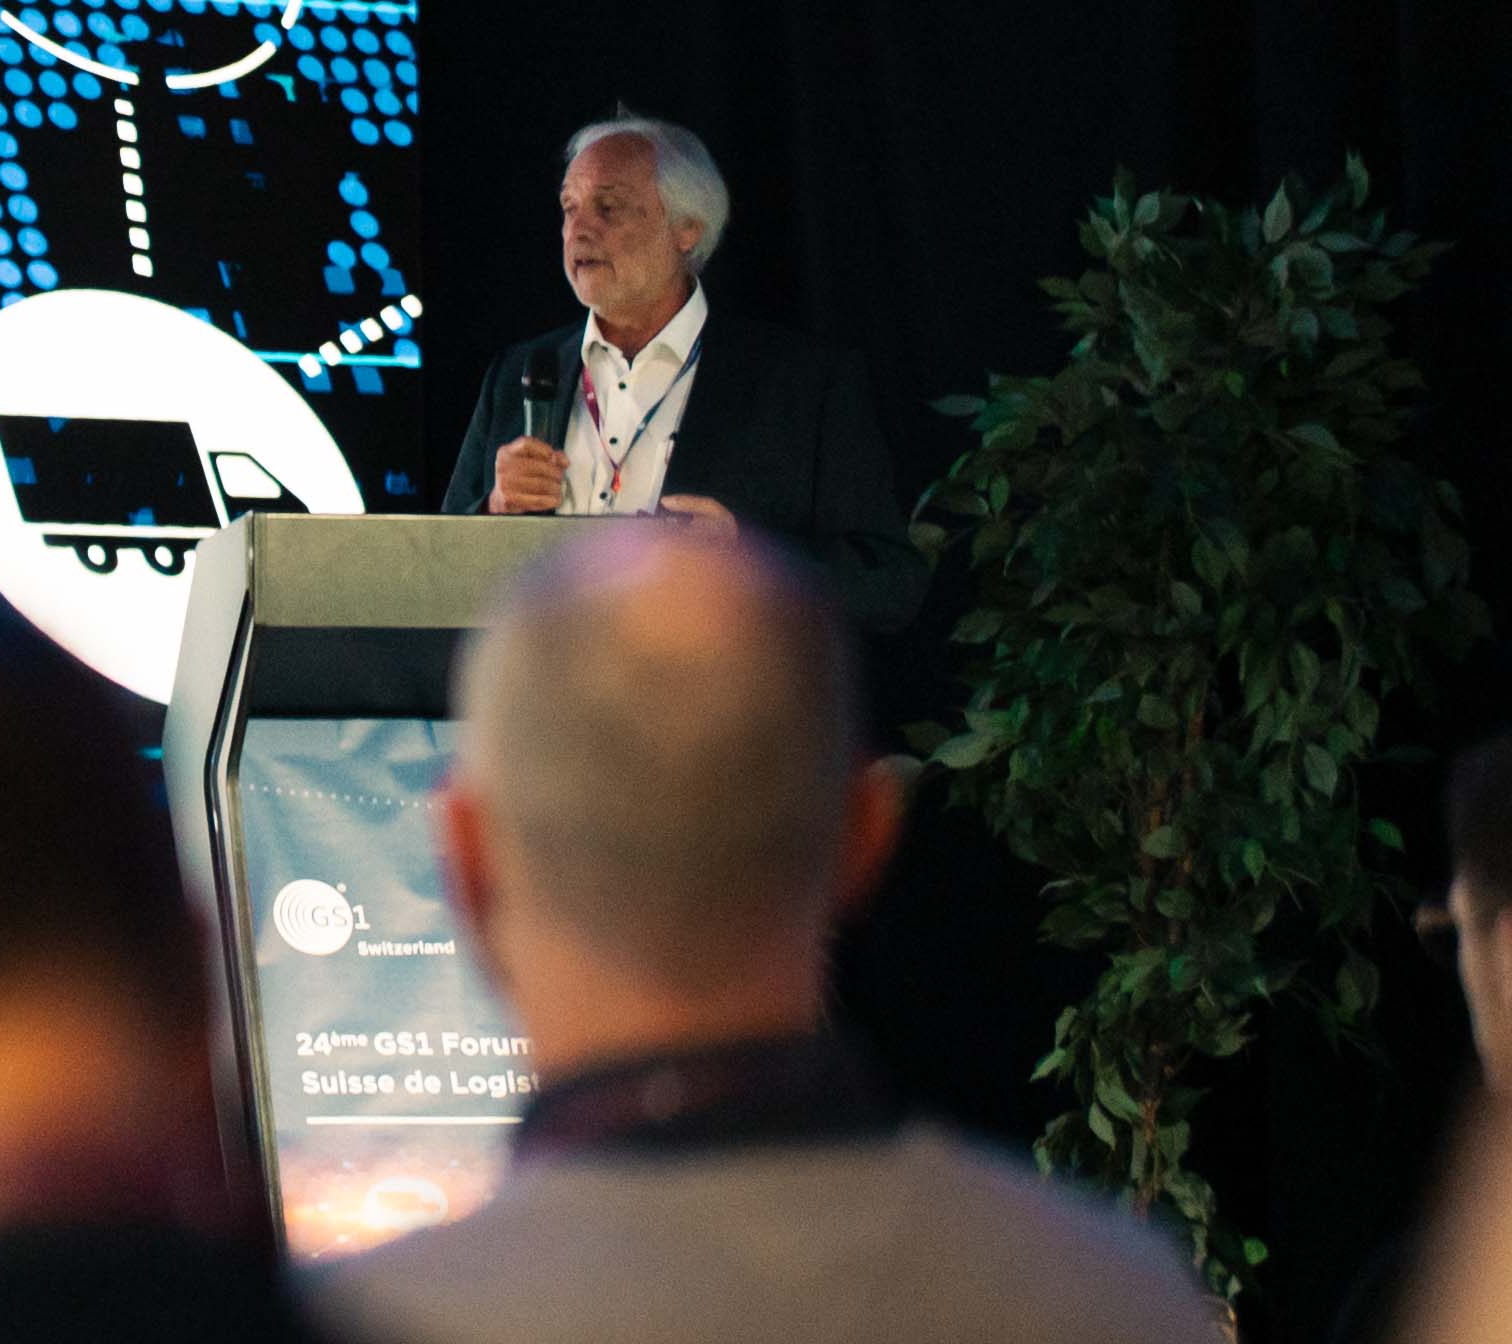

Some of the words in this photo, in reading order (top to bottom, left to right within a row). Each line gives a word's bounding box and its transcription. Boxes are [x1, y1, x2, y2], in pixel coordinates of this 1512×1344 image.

[357, 940, 456, 956] Switzerland
[374, 1032, 433, 1057] GS1
[301, 1070, 396, 1096] Suisse
[404, 1070, 442, 1094] de
